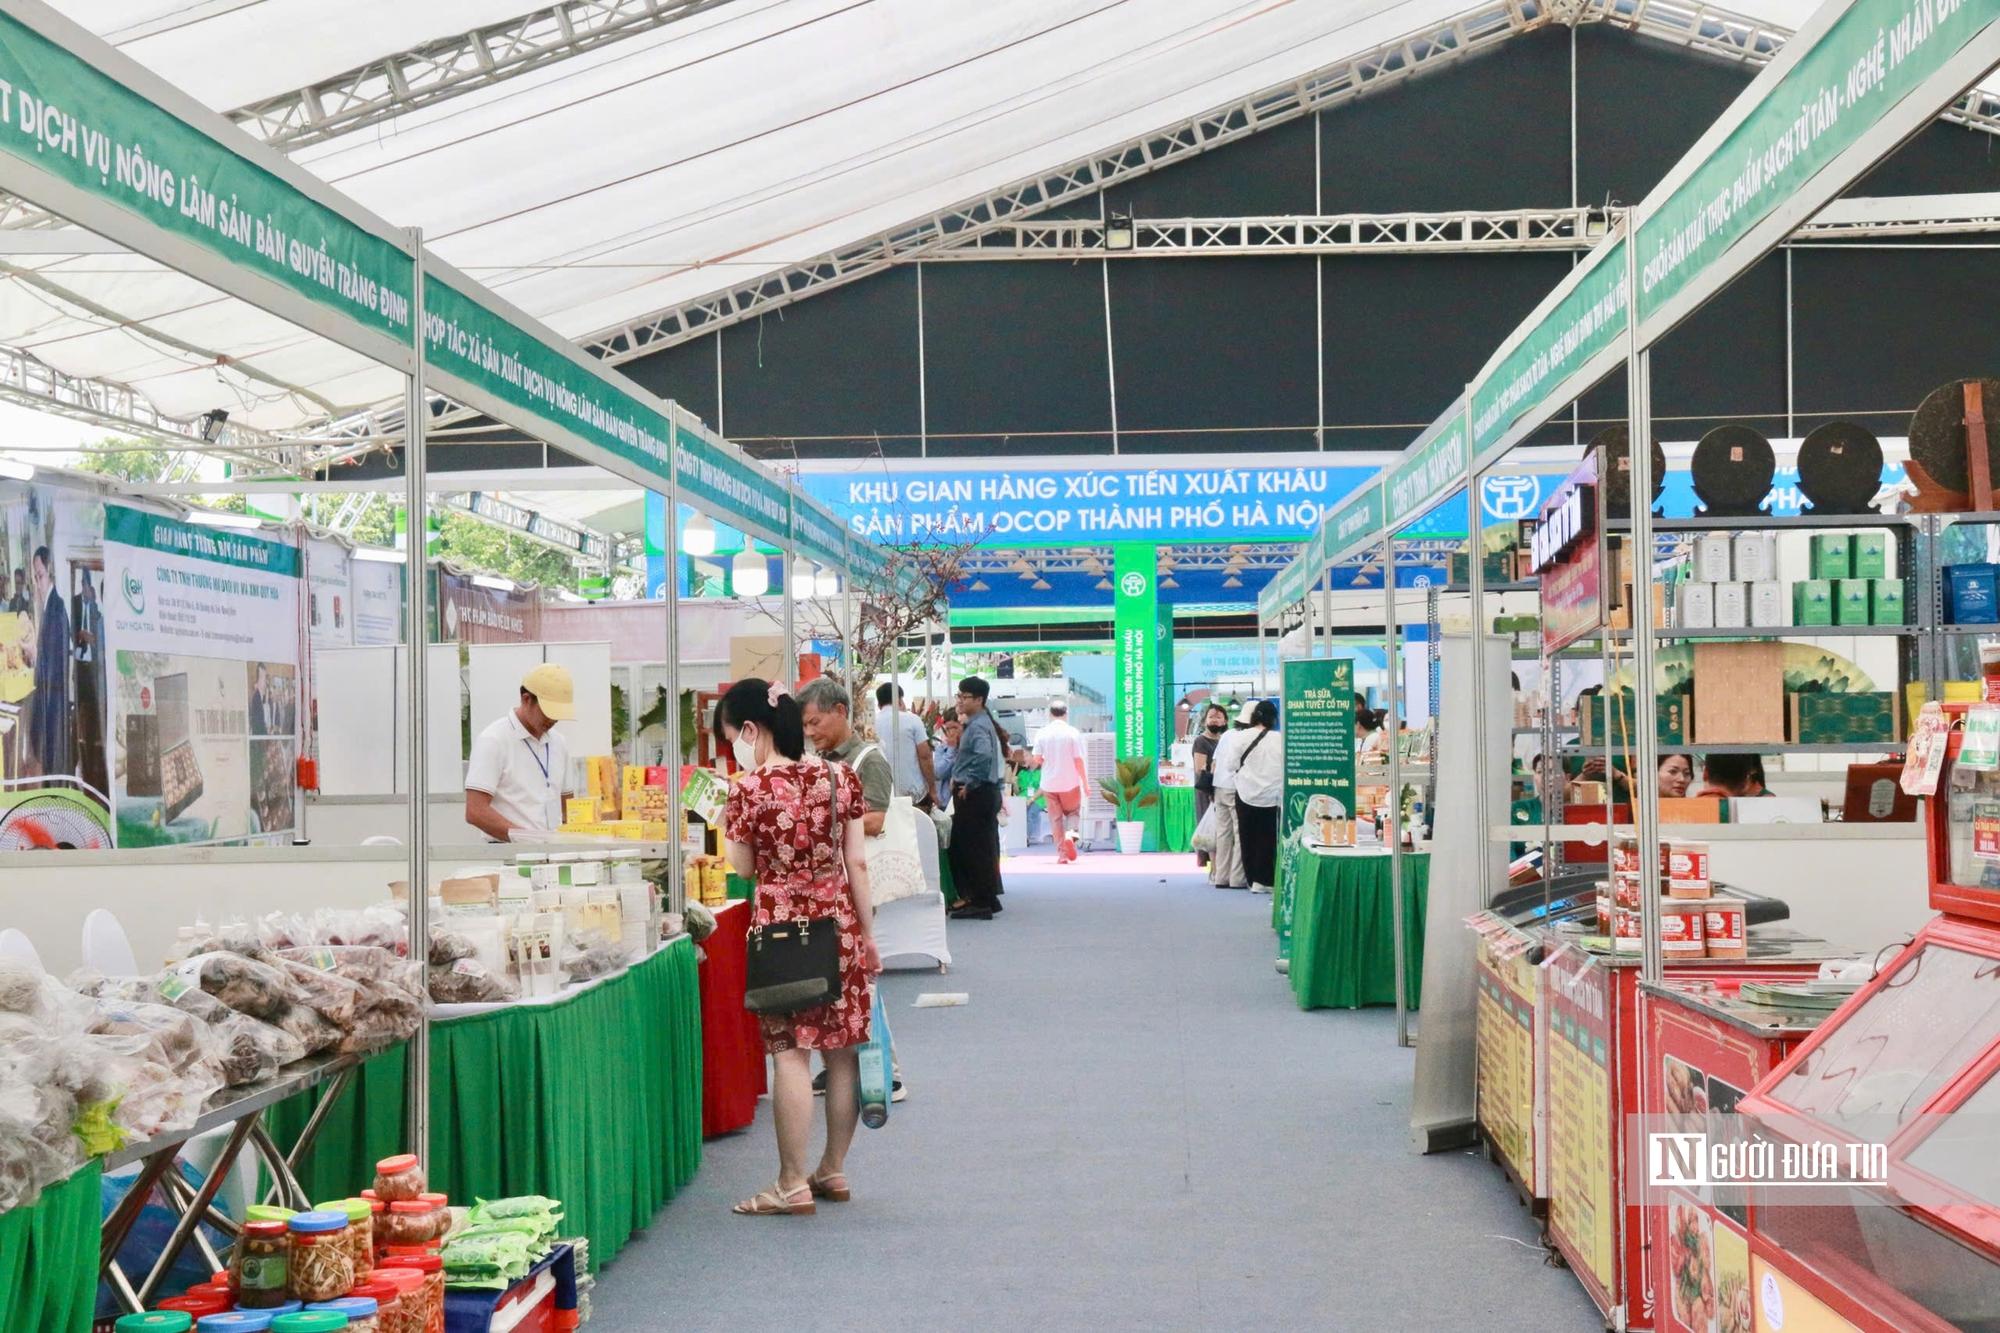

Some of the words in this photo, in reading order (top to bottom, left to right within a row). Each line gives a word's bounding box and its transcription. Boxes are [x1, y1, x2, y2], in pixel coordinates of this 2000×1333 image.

[1764, 127, 1793, 189] SẠCH
[1811, 85, 1837, 141] TÂM
[1847, 27, 1886, 109] NGHỆ
[1890, 0, 1933, 70] NHÂN
[19, 90, 77, 158] DỊCH
[81, 125, 109, 185] VỤ
[117, 144, 175, 207] NÔNG
[180, 174, 215, 230] LÂM
[219, 194, 251, 247] SẢN
[256, 214, 285, 265] BẢN
[289, 238, 335, 290] QUYỀN
[338, 258, 377, 312] TRÀNG
[380, 286, 408, 328] ĐỊNH
[423, 310, 445, 350] HỢP
[447, 320, 466, 357] TÁC
[482, 337, 499, 376] SẢN
[501, 351, 522, 387] XUẤT
[524, 367, 544, 400] DỊCH
[544, 377, 555, 411] VỤ
[556, 381, 577, 416] NÔNG
[578, 393, 591, 424] LÂM
[849, 482, 899, 504] KHU
[906, 480, 973, 502] GIAN
[980, 472, 1056, 499] HÀNG
[1065, 470, 1120, 498] XÚC
[1126, 468, 1178, 497] TIẾN
[1184, 467, 1253, 496] XUẤT
[851, 506, 901, 535] SẢN
[911, 503, 984, 534] PHẨM
[994, 509, 1070, 533] OCOP
[1077, 501, 1163, 530] THÀNH
[1170, 499, 1225, 528] PHỐ
[1232, 501, 1268, 527] HÀ
[1277, 499, 1325, 530] NỘI
[1317, 687, 1331, 699] SỮA
